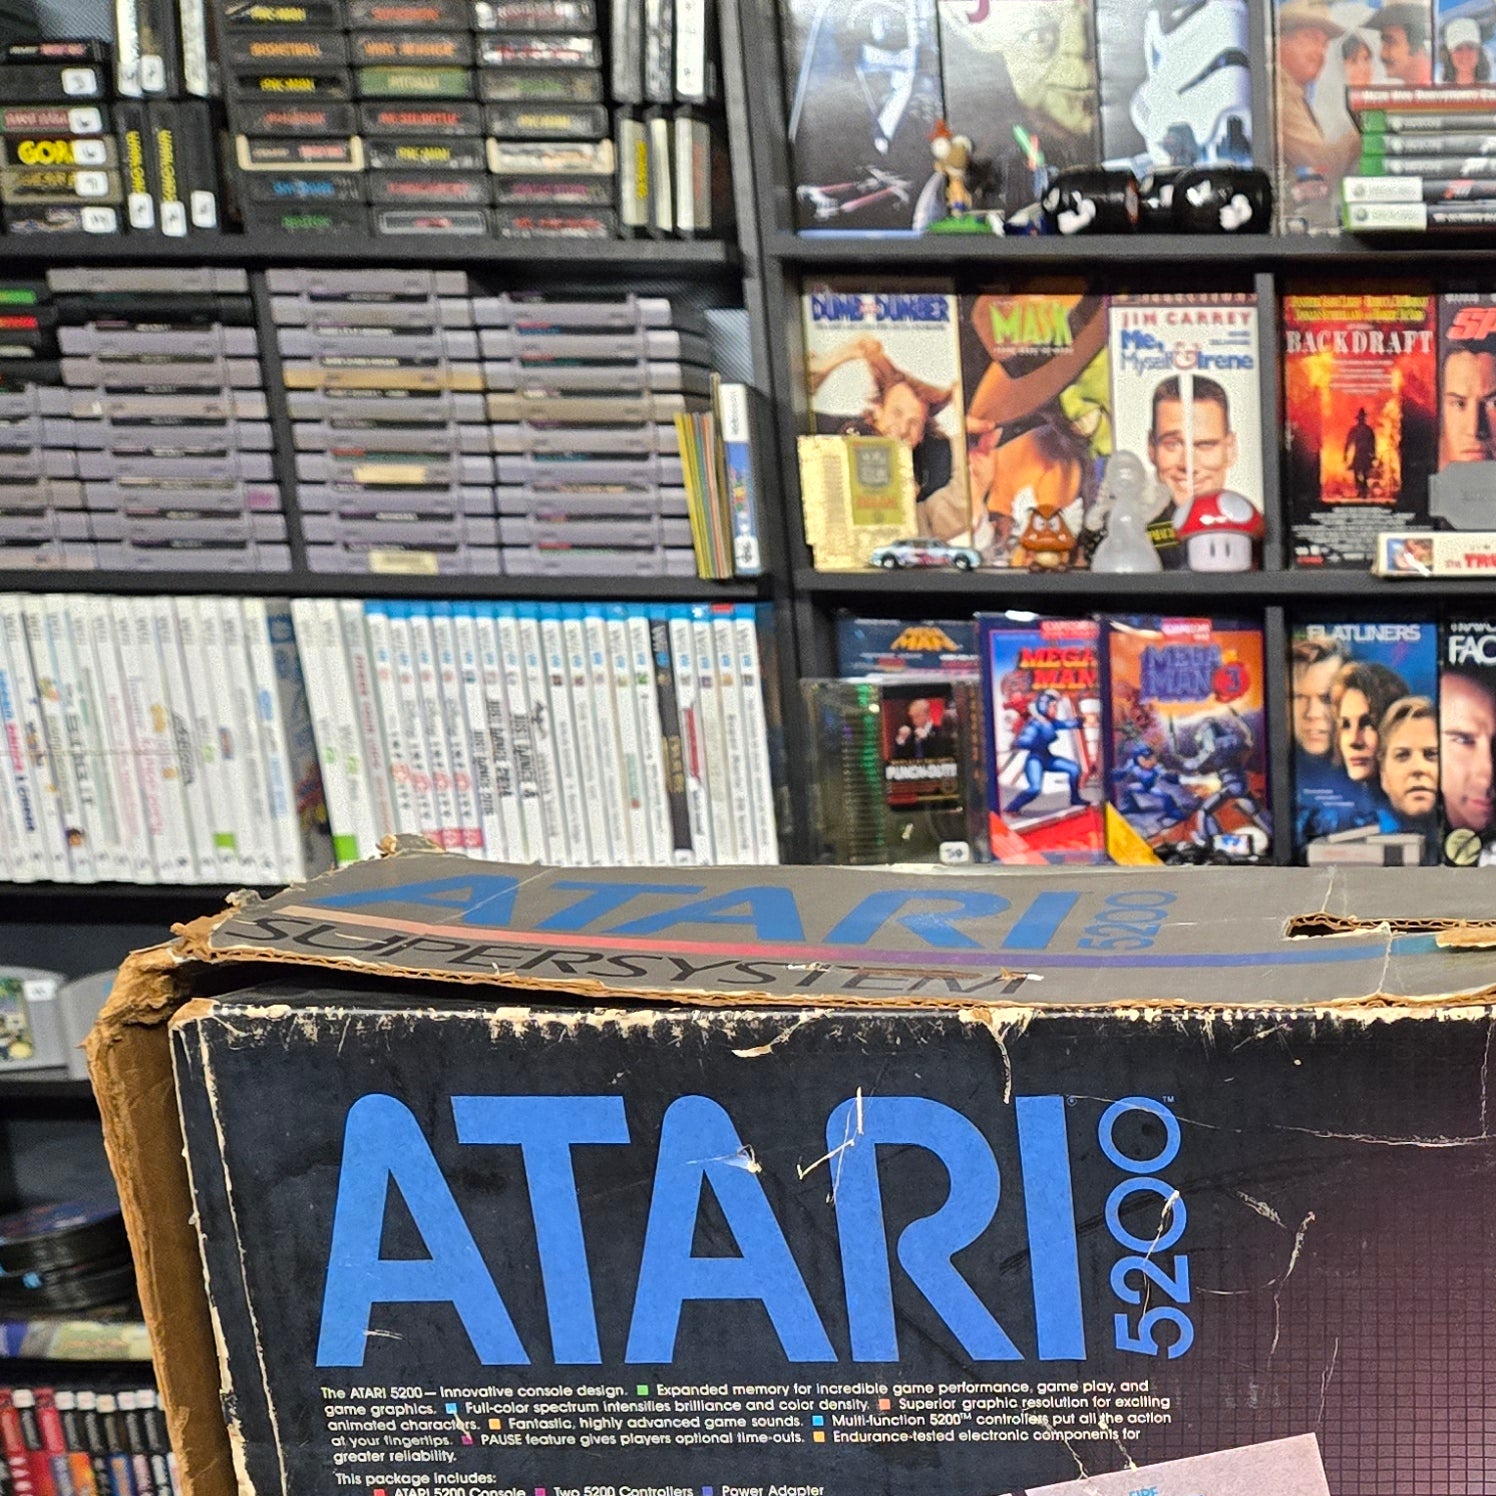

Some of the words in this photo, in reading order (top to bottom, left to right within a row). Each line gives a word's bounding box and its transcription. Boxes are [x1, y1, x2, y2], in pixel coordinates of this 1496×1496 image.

[18, 139, 75, 165] GOR
[989, 302, 1074, 343] MASK
[1121, 312, 1158, 327] JIM
[1166, 310, 1252, 326] CARREY
[1120, 330, 1165, 350] Me,
[1286, 330, 1434, 354] BACKDRAFT
[1199, 353, 1254, 370] Irene
[1307, 625, 1421, 642] FLATLINERS
[1020, 648, 1096, 668] MEGA
[1031, 667, 1096, 689] MAN
[1142, 670, 1213, 699] MAN
[306, 872, 1082, 950] ATARI
[1075, 890, 1178, 951] 5200
[222, 916, 1035, 994] SUPERSYSTEM
[316, 1093, 1088, 1368] ATARI
[1097, 1096, 1196, 1362] 5200
[321, 1387, 346, 1399] The
[350, 1387, 387, 1399] ATARI
[516, 1386, 573, 1398] console
[577, 1385, 628, 1400] design.
[657, 1384, 726, 1399] Expanded
[731, 1383, 789, 1397] memory
[794, 1382, 813, 1395] for
[816, 1382, 888, 1395] incredible
[892, 1383, 934, 1396] game
[1037, 1381, 1078, 1395] game
[1121, 1380, 1148, 1392] and
[335, 1472, 363, 1485] This
[366, 1472, 430, 1488] package
[434, 1472, 497, 1484] includes:
